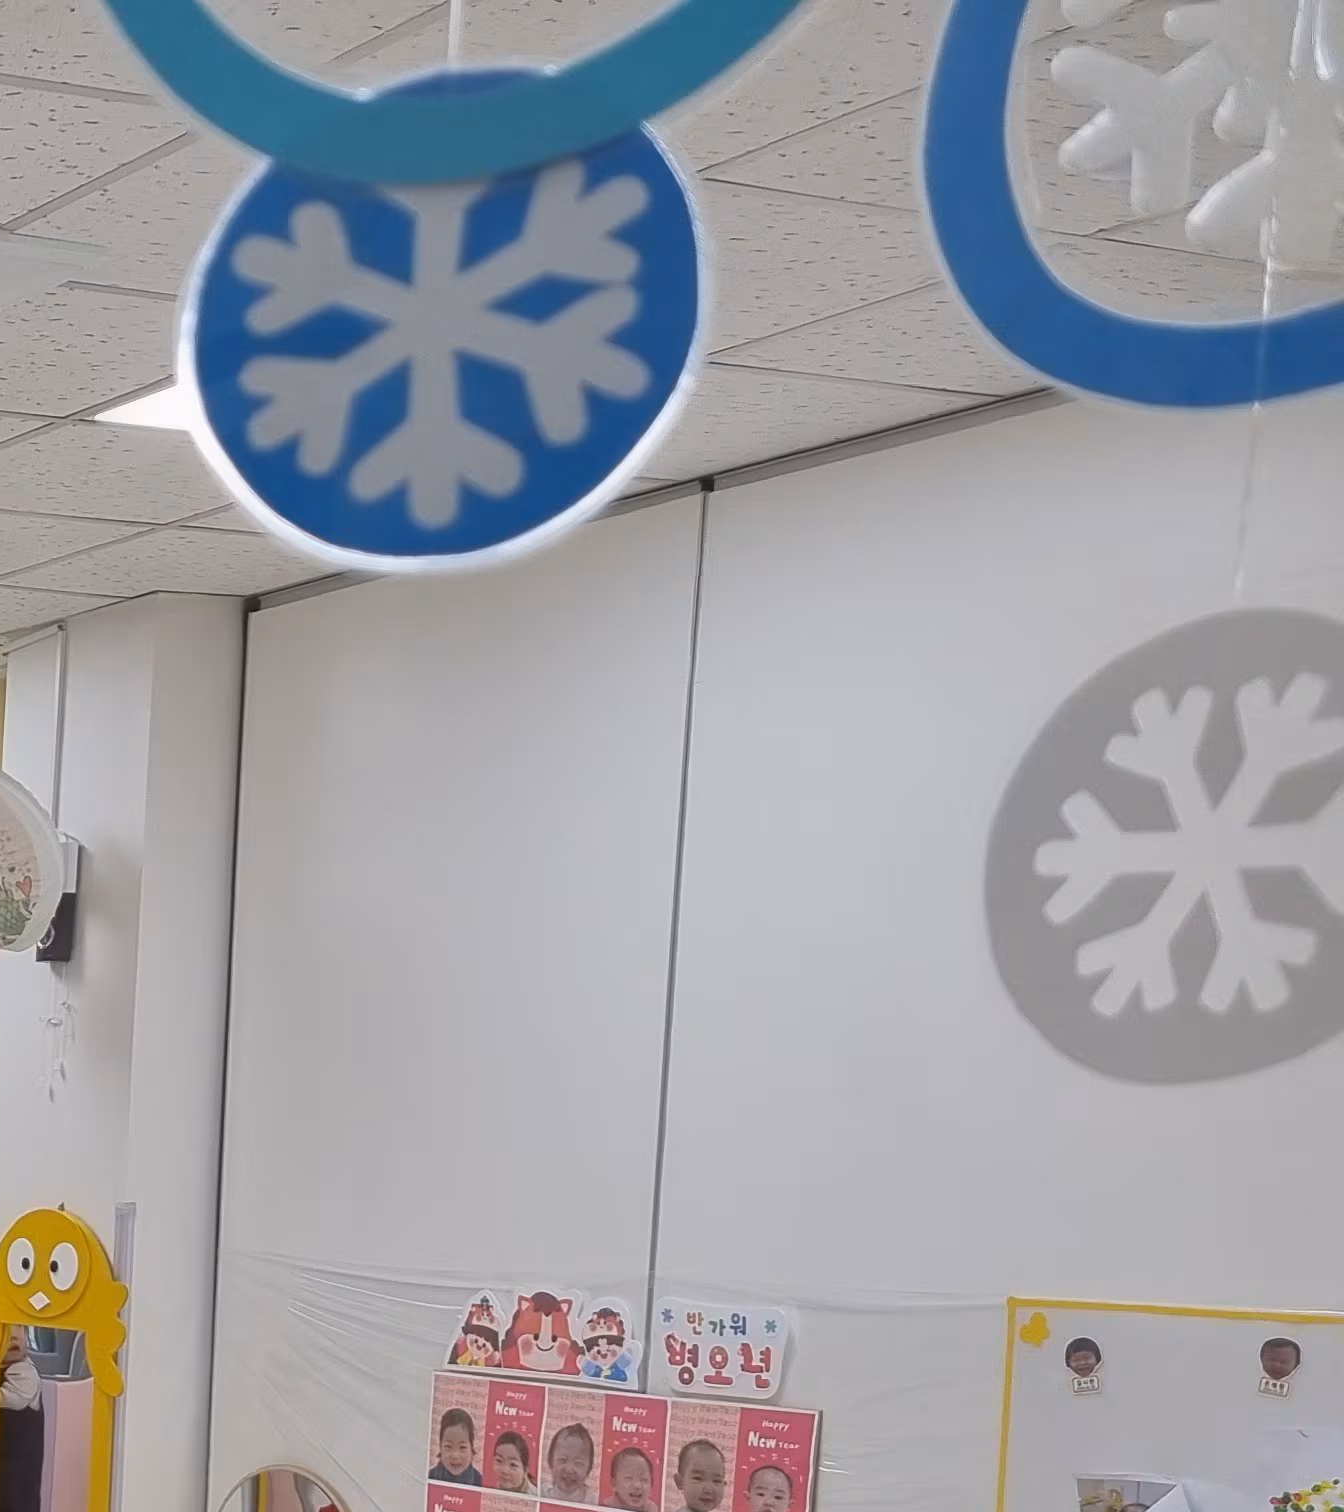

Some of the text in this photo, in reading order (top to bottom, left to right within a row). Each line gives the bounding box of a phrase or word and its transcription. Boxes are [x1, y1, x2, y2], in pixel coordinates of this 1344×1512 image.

[686, 1311, 747, 1337] 반가워
[664, 1332, 772, 1389] 병오년
[495, 1400, 517, 1416] New
[612, 1416, 638, 1433] New
[748, 1430, 777, 1449] New
